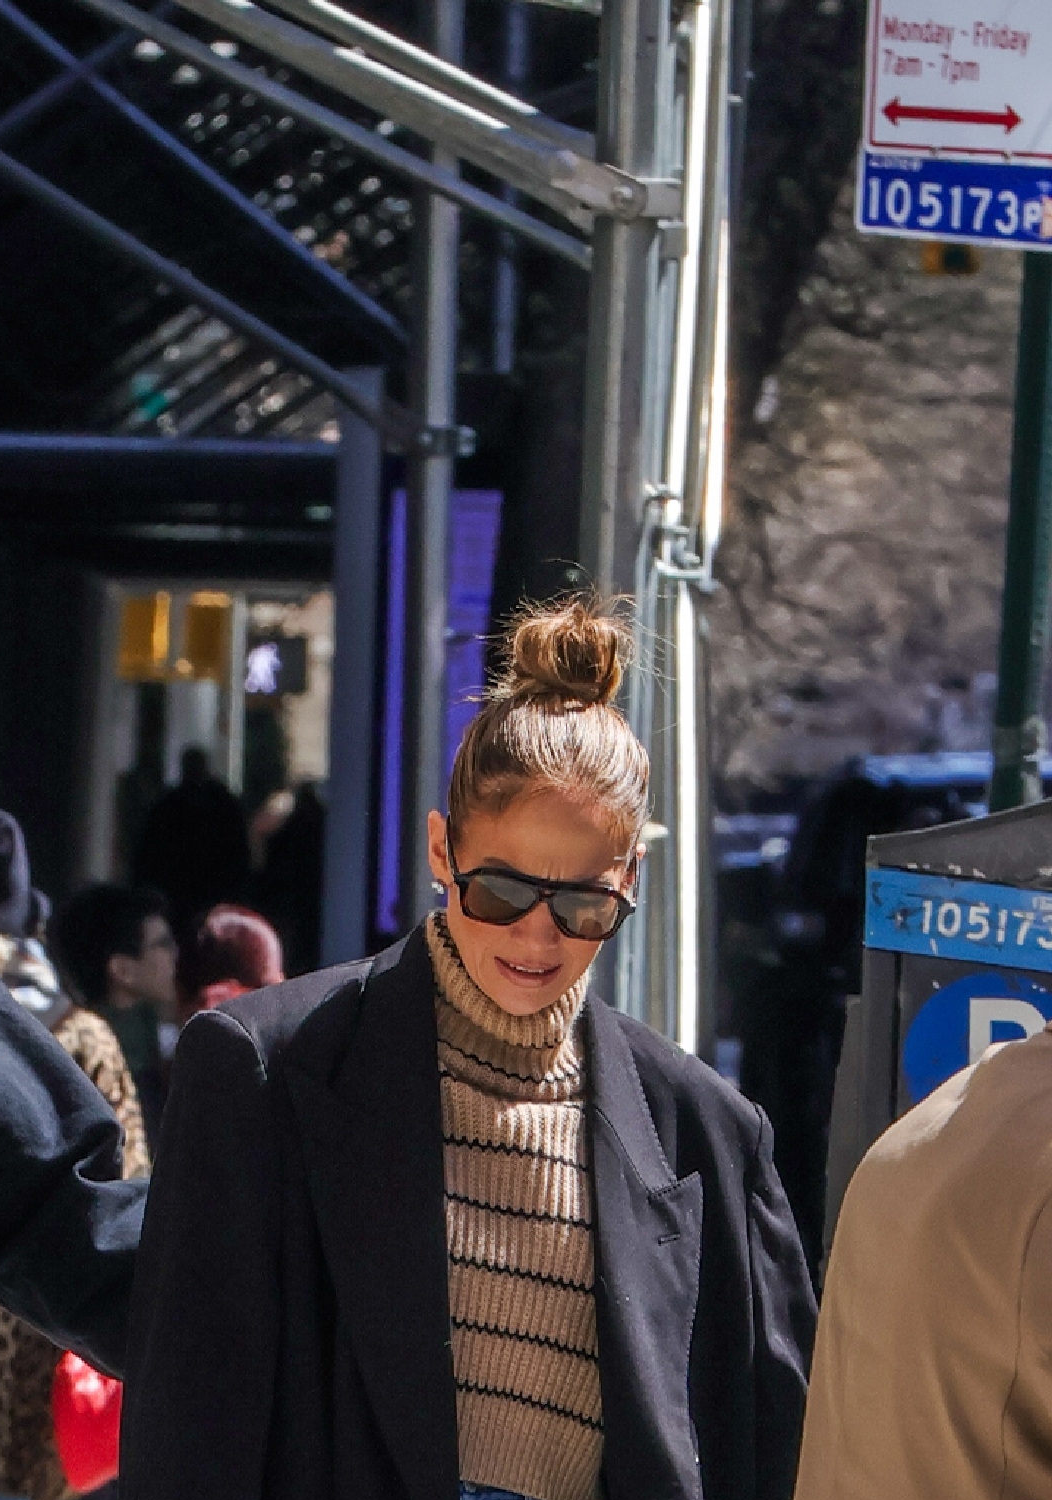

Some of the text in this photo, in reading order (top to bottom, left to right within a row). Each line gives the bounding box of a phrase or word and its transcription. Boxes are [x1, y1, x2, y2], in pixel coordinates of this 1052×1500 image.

[883, 15, 954, 48] Monday
[973, 21, 1031, 56] Friday
[883, 49, 923, 77] 7am
[940, 53, 980, 84] 7pm
